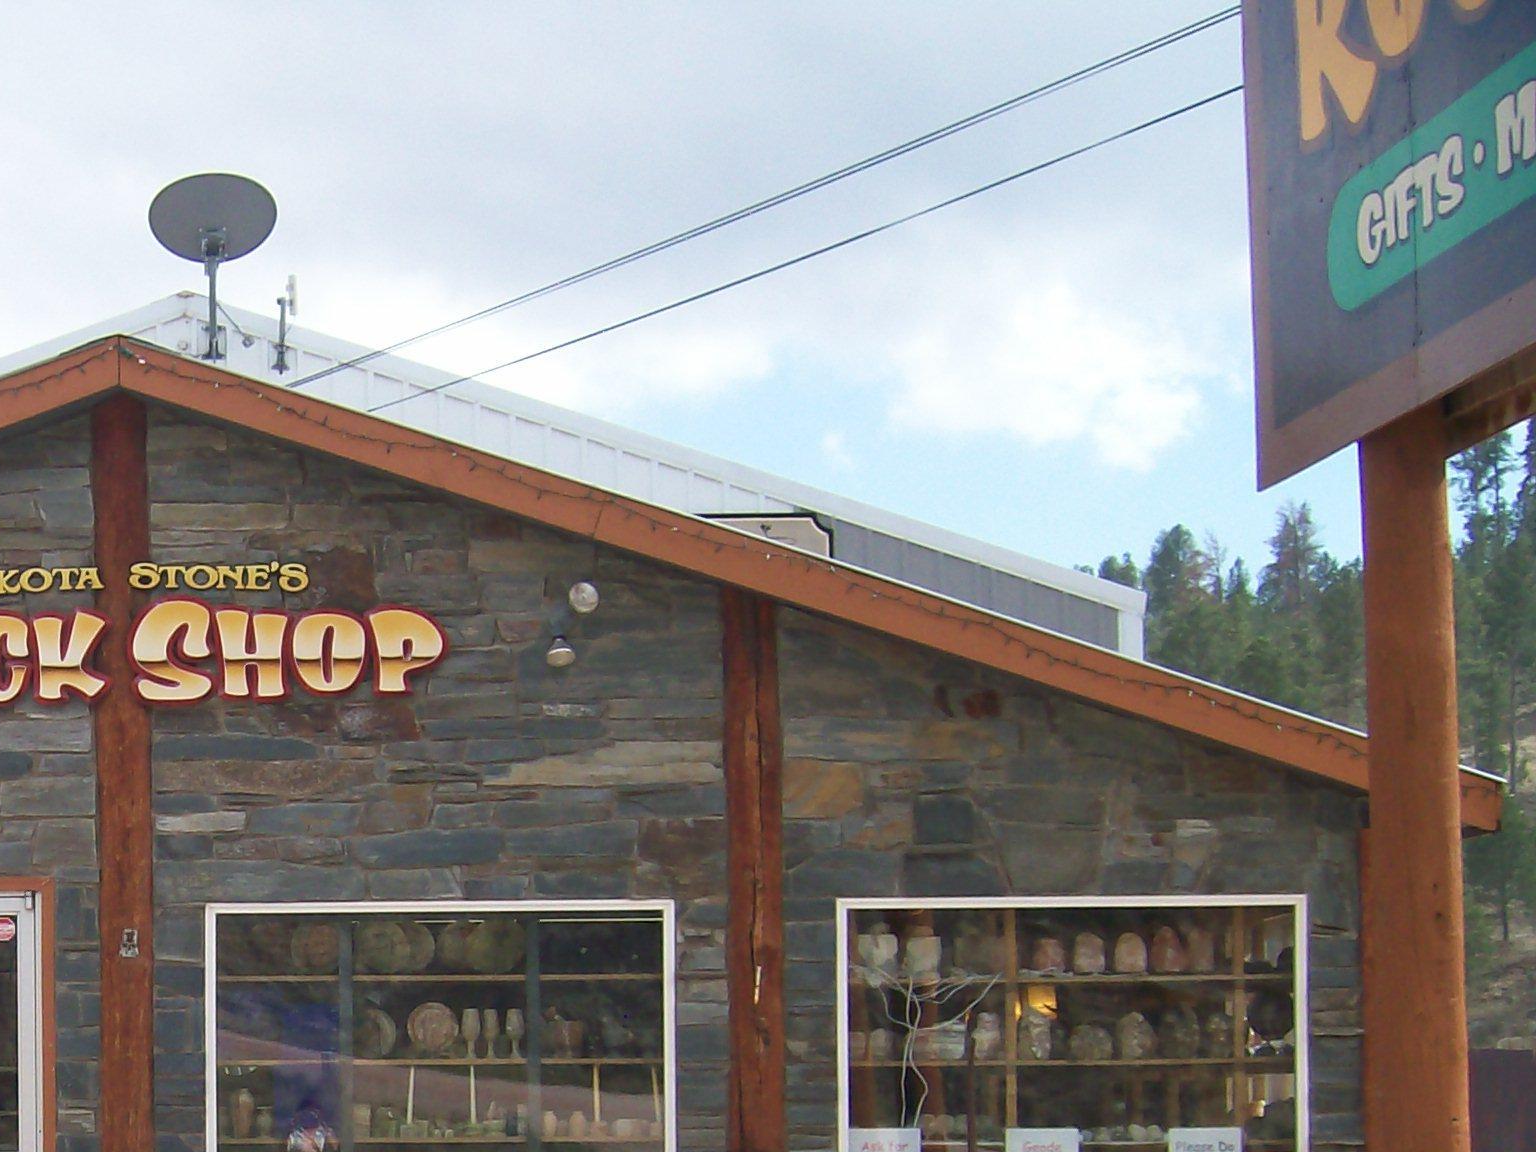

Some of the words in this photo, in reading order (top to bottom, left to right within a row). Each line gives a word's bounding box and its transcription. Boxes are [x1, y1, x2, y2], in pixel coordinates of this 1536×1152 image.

[1356, 134, 1465, 265] GIFTS
[129, 561, 308, 592] STONE'S
[132, 599, 443, 701] SHOP
[1174, 1141, 1213, 1152] Please
[1217, 1141, 1235, 1152] Do
